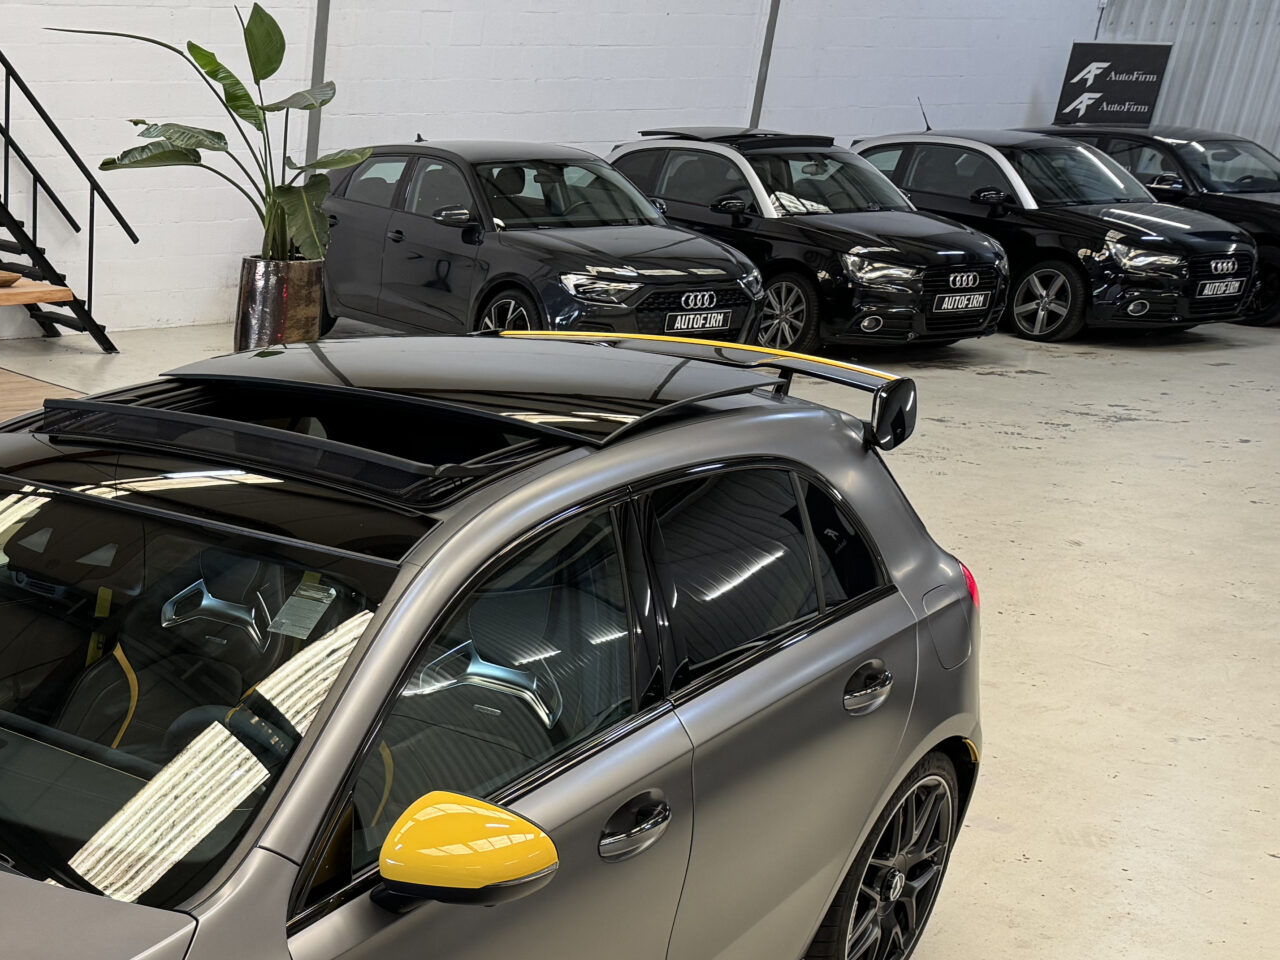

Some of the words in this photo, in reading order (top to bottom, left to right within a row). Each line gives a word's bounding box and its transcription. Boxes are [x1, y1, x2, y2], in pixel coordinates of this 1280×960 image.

[1106, 71, 1157, 81] AutoFirm
[1098, 101, 1148, 112] AutoFirm
[1202, 281, 1240, 295] AUTOFIRM
[941, 294, 985, 310] AUTOFIRM
[673, 313, 724, 329] AUTOFIRM
